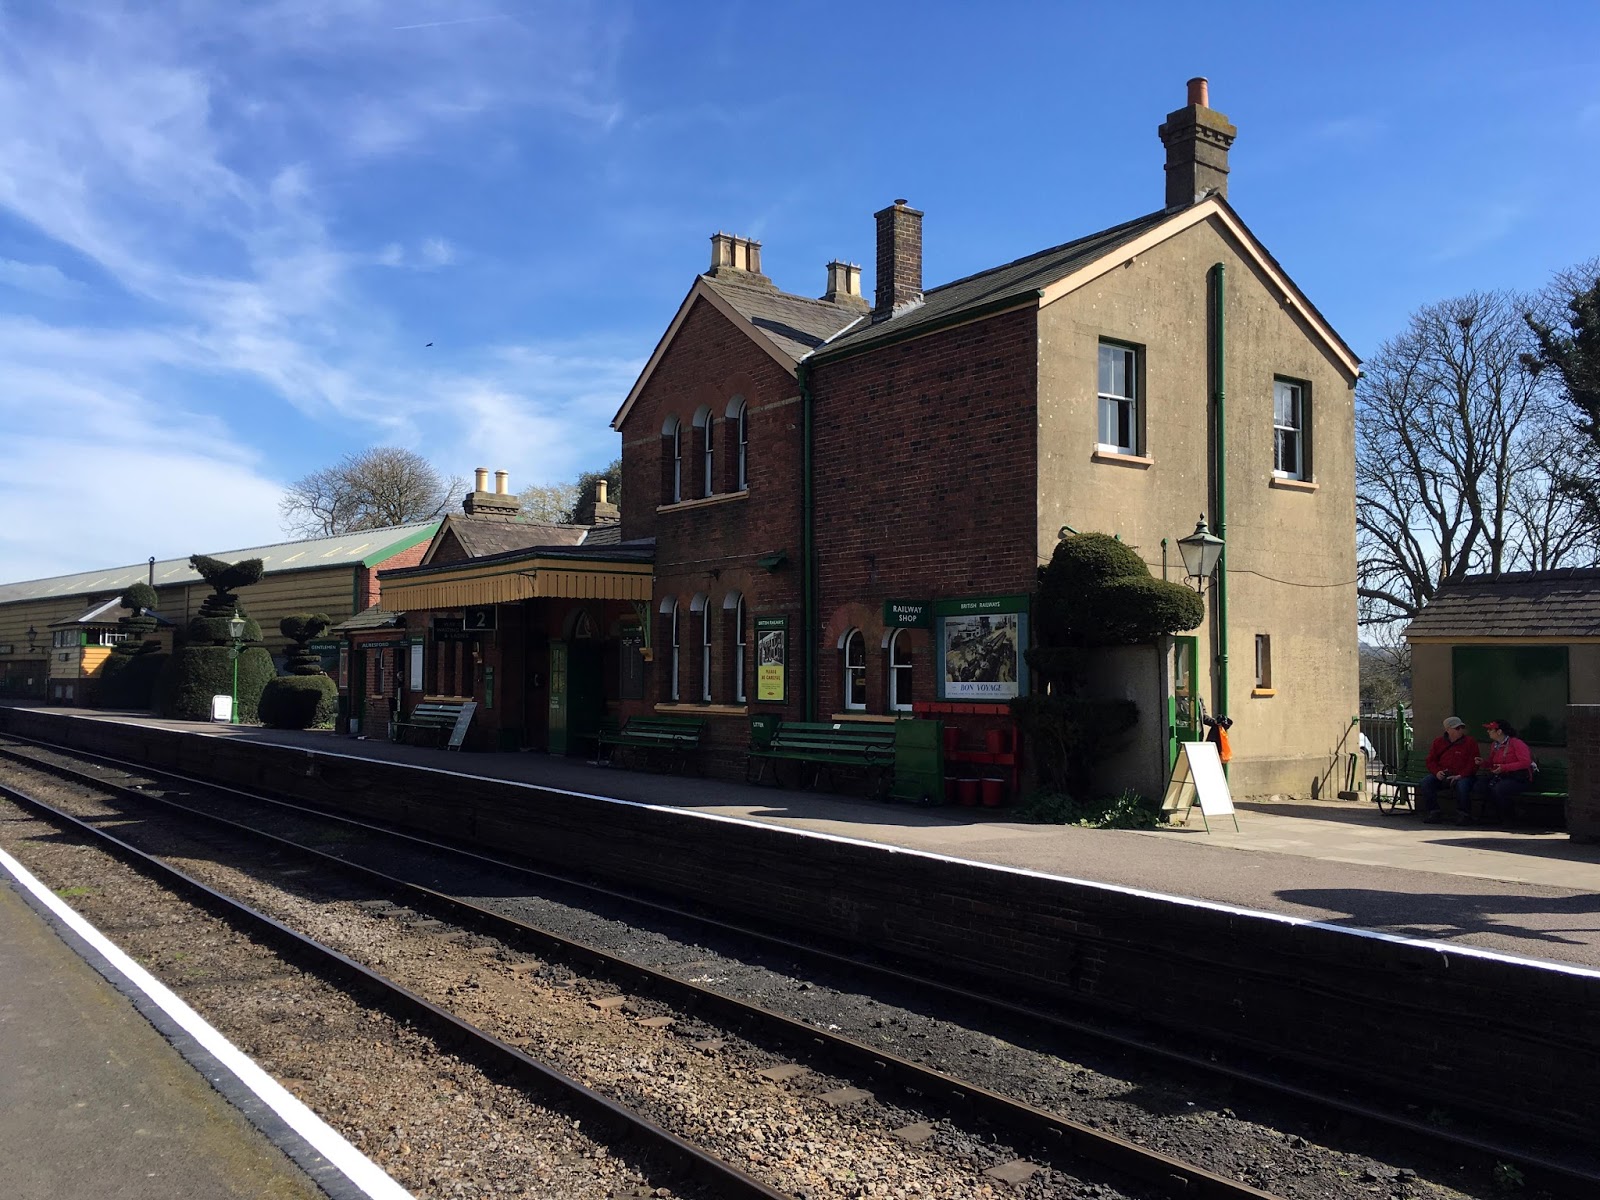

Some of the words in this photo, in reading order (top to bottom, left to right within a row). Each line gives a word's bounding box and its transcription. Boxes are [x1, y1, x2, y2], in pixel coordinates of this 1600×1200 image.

[892, 605, 922, 614] RAILWAY
[476, 611, 486, 627] 2
[898, 614, 917, 622] SHOP
